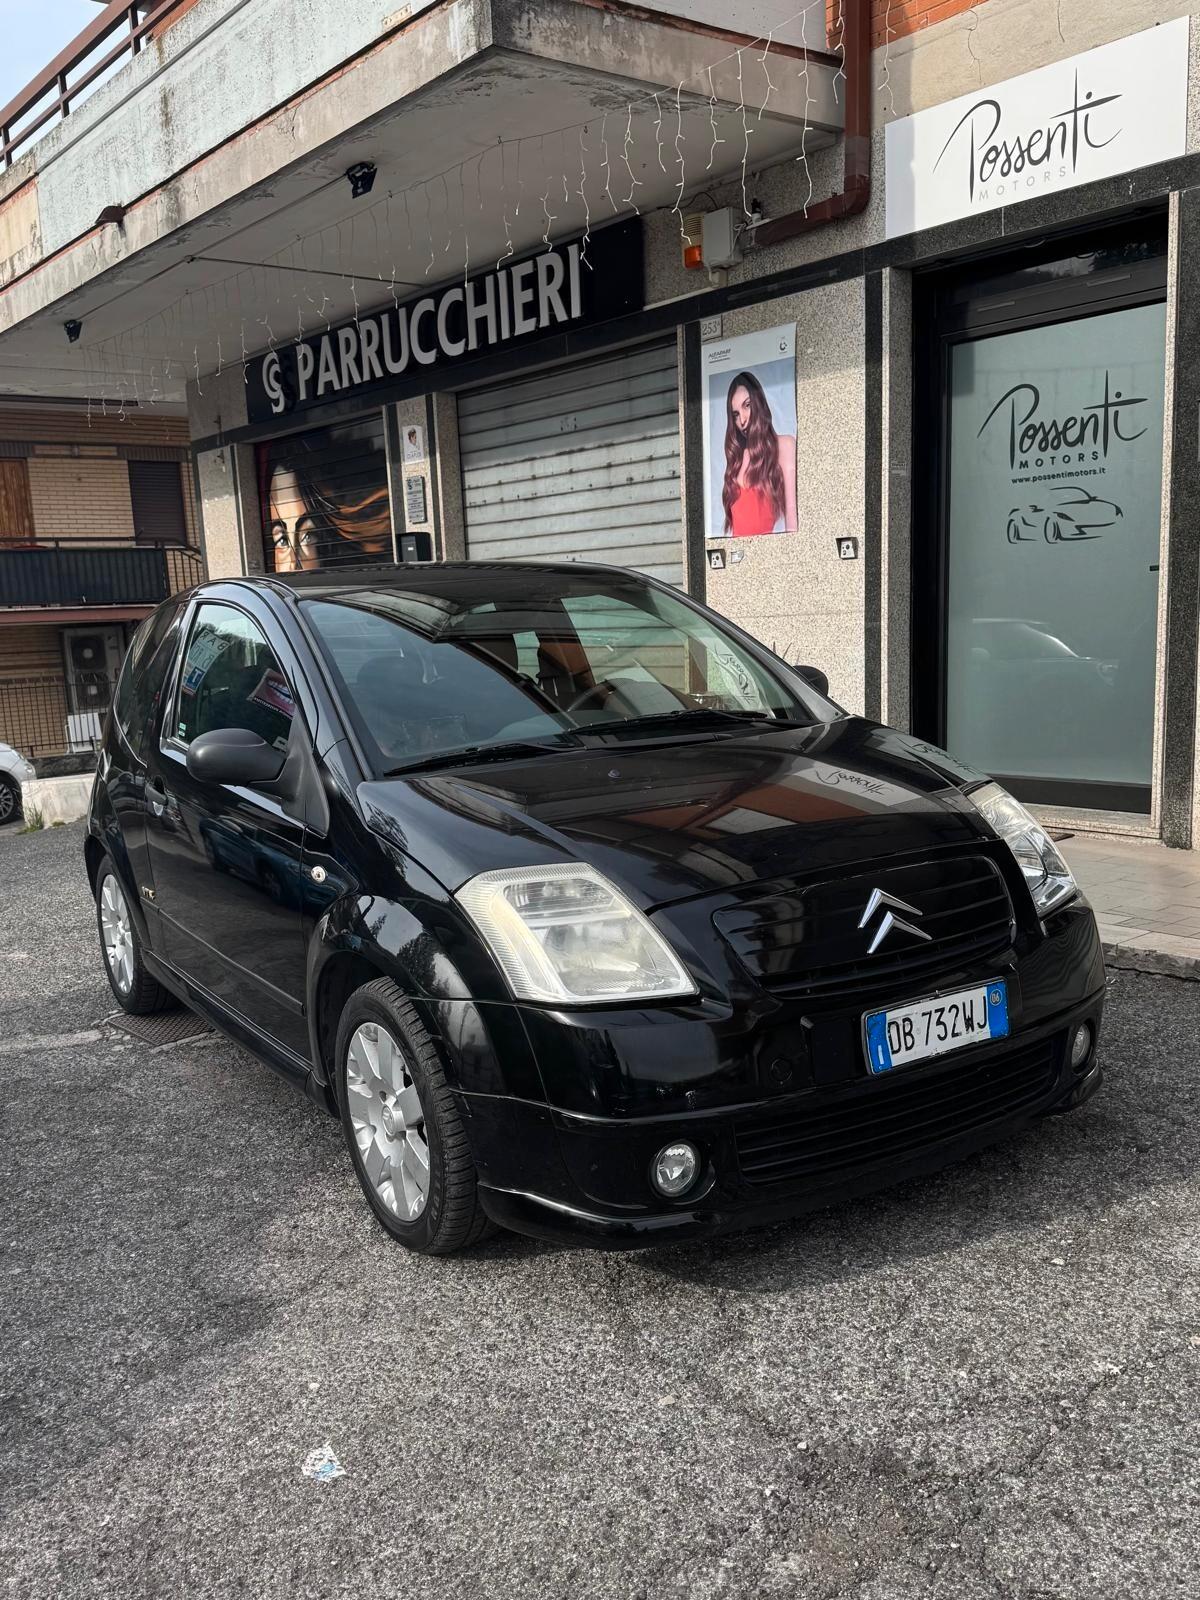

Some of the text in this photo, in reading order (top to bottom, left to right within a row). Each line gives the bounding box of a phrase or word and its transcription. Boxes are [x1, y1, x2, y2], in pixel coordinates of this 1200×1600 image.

[932, 66, 1123, 204] Possenti
[978, 165, 1067, 202] MOTORS
[295, 243, 584, 401] PARRUCCHIERI
[976, 369, 1149, 470] Possenti
[1011, 466, 1107, 485] www.possentimotors.it
[1018, 450, 1100, 470] MOTORS
